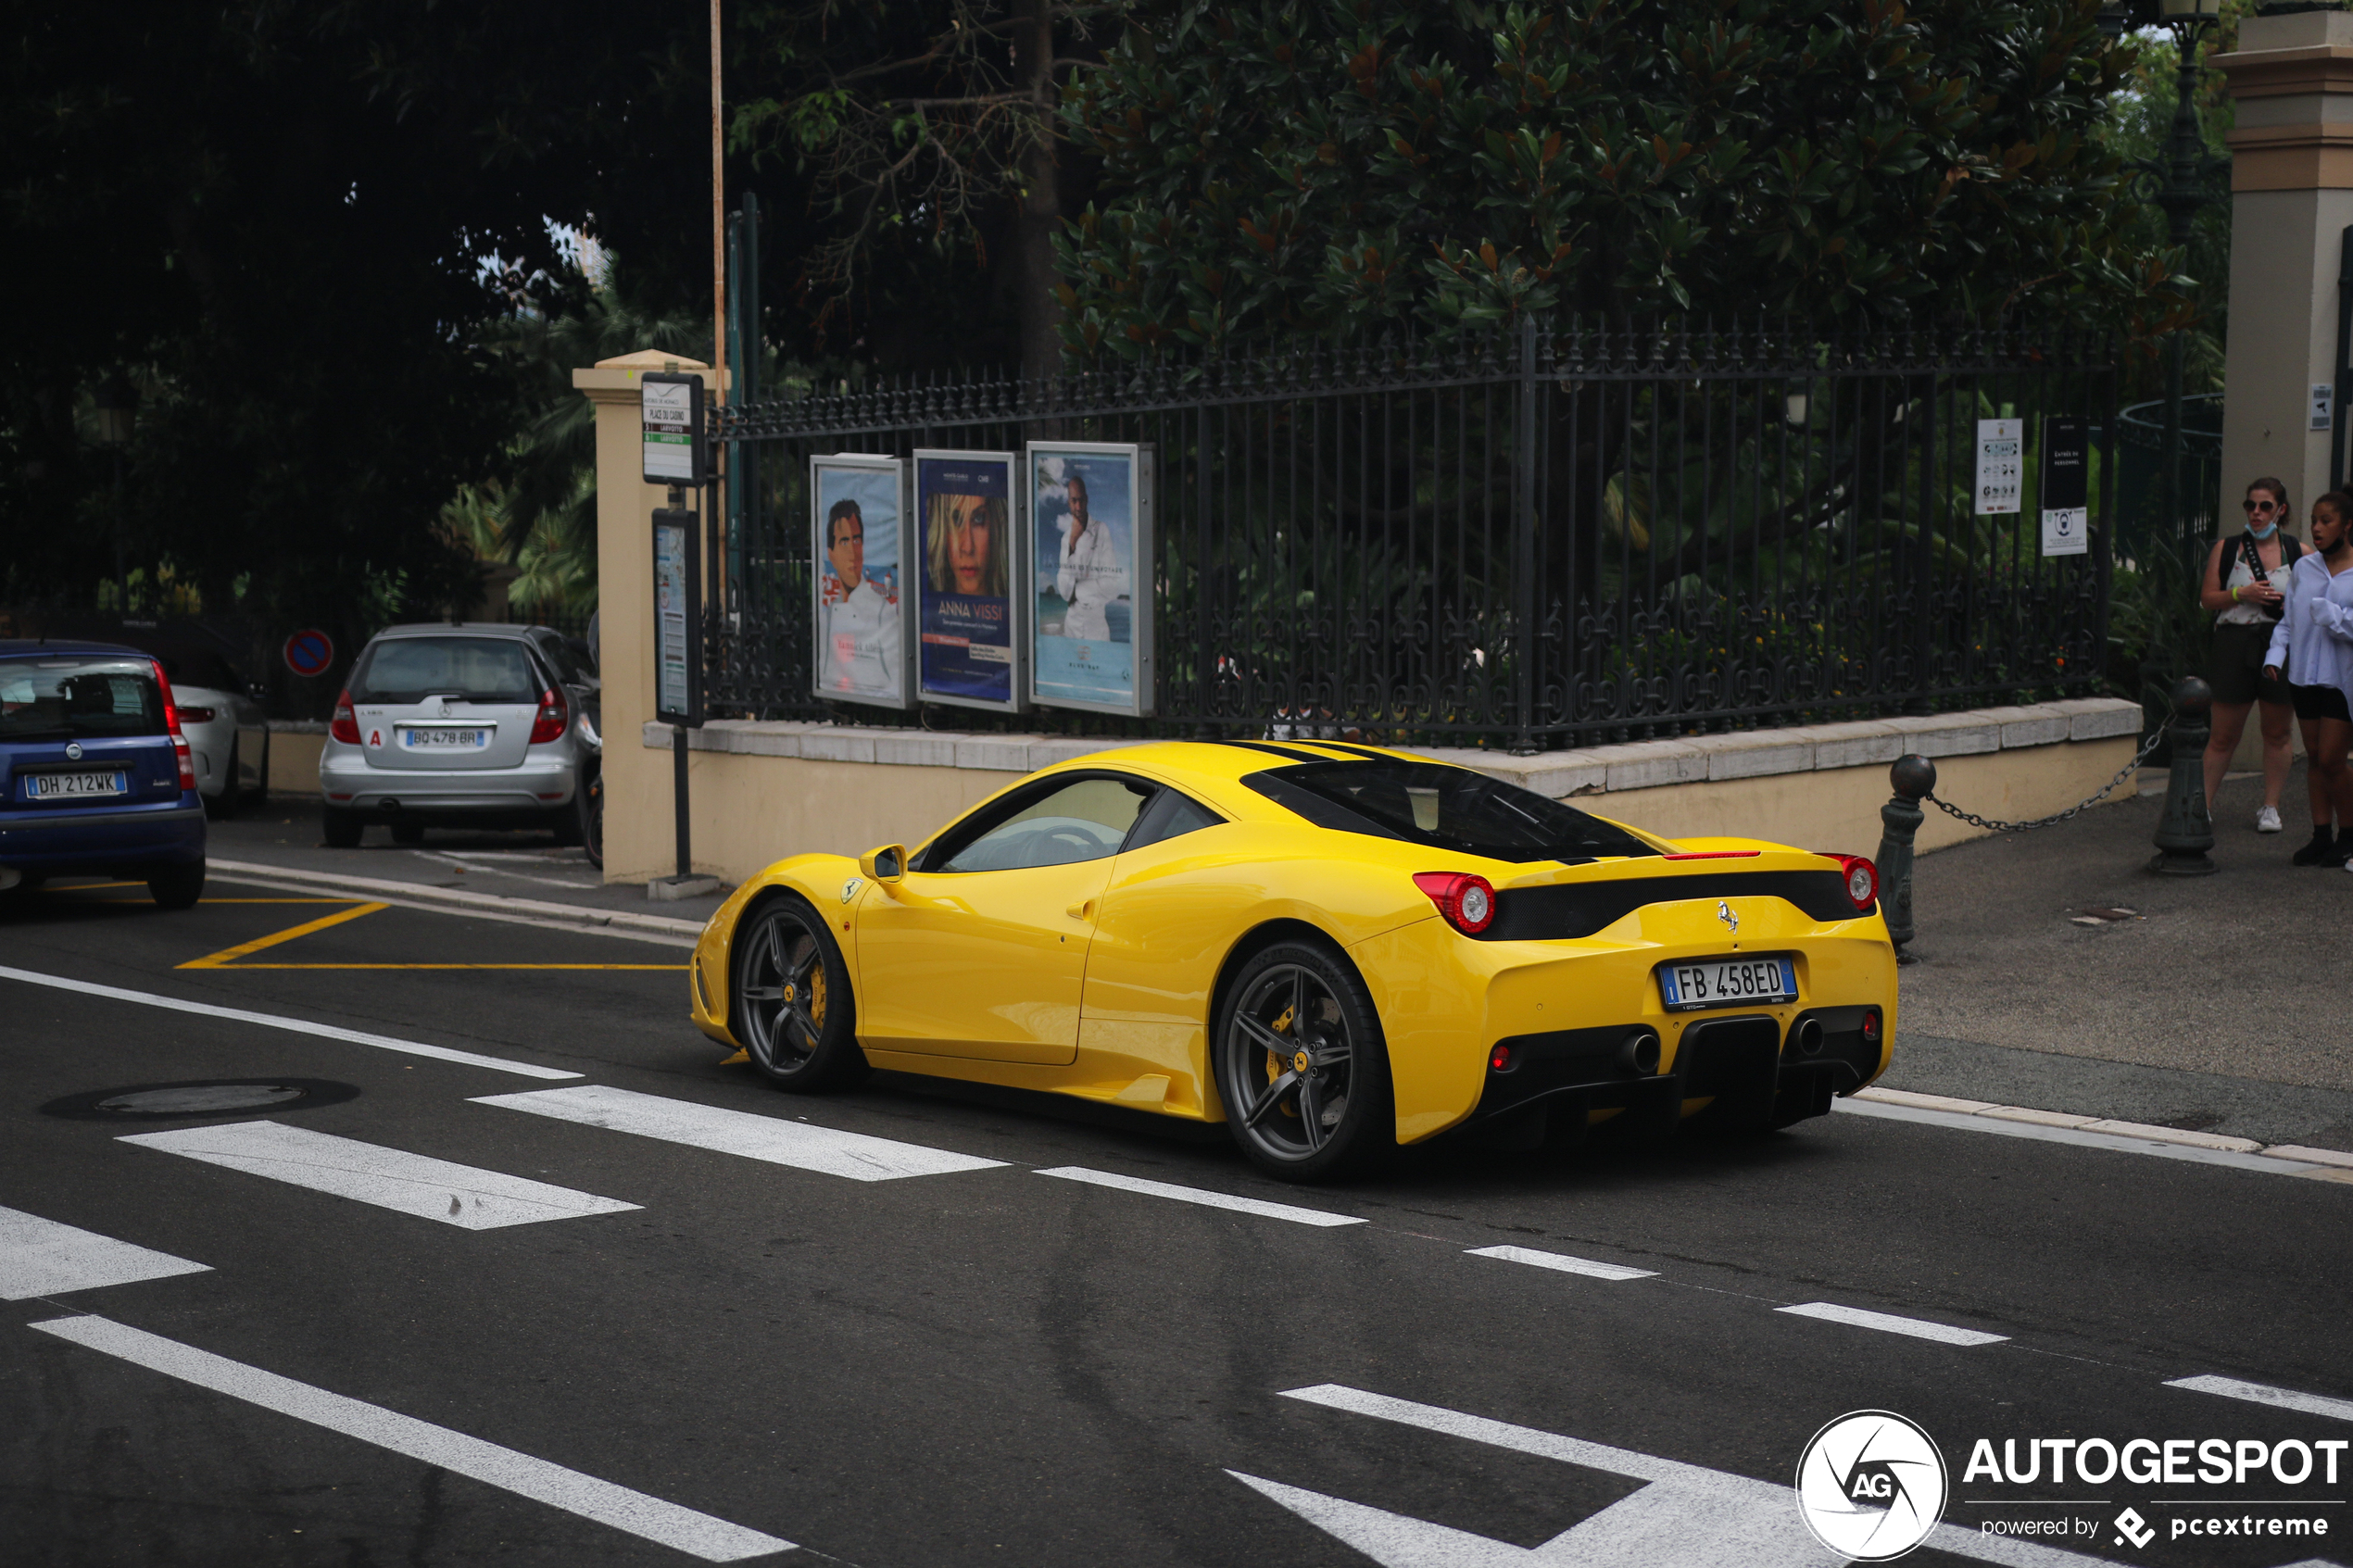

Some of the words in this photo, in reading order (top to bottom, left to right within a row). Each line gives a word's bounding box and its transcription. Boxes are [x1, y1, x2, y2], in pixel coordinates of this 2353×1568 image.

[650, 408, 661, 420] PLACE
[663, 409, 669, 420] DU
[670, 410, 684, 421] CASINO
[660, 425, 683, 433] LARVOTTO
[660, 436, 683, 444] LARVOTTO
[938, 600, 971, 618] ANNA
[973, 603, 1003, 621] VISSI
[370, 730, 381, 746] A
[39, 776, 60, 794] DH
[66, 775, 114, 792] 212WK
[1678, 968, 1707, 999] FB
[1717, 963, 1780, 996] 458ED
